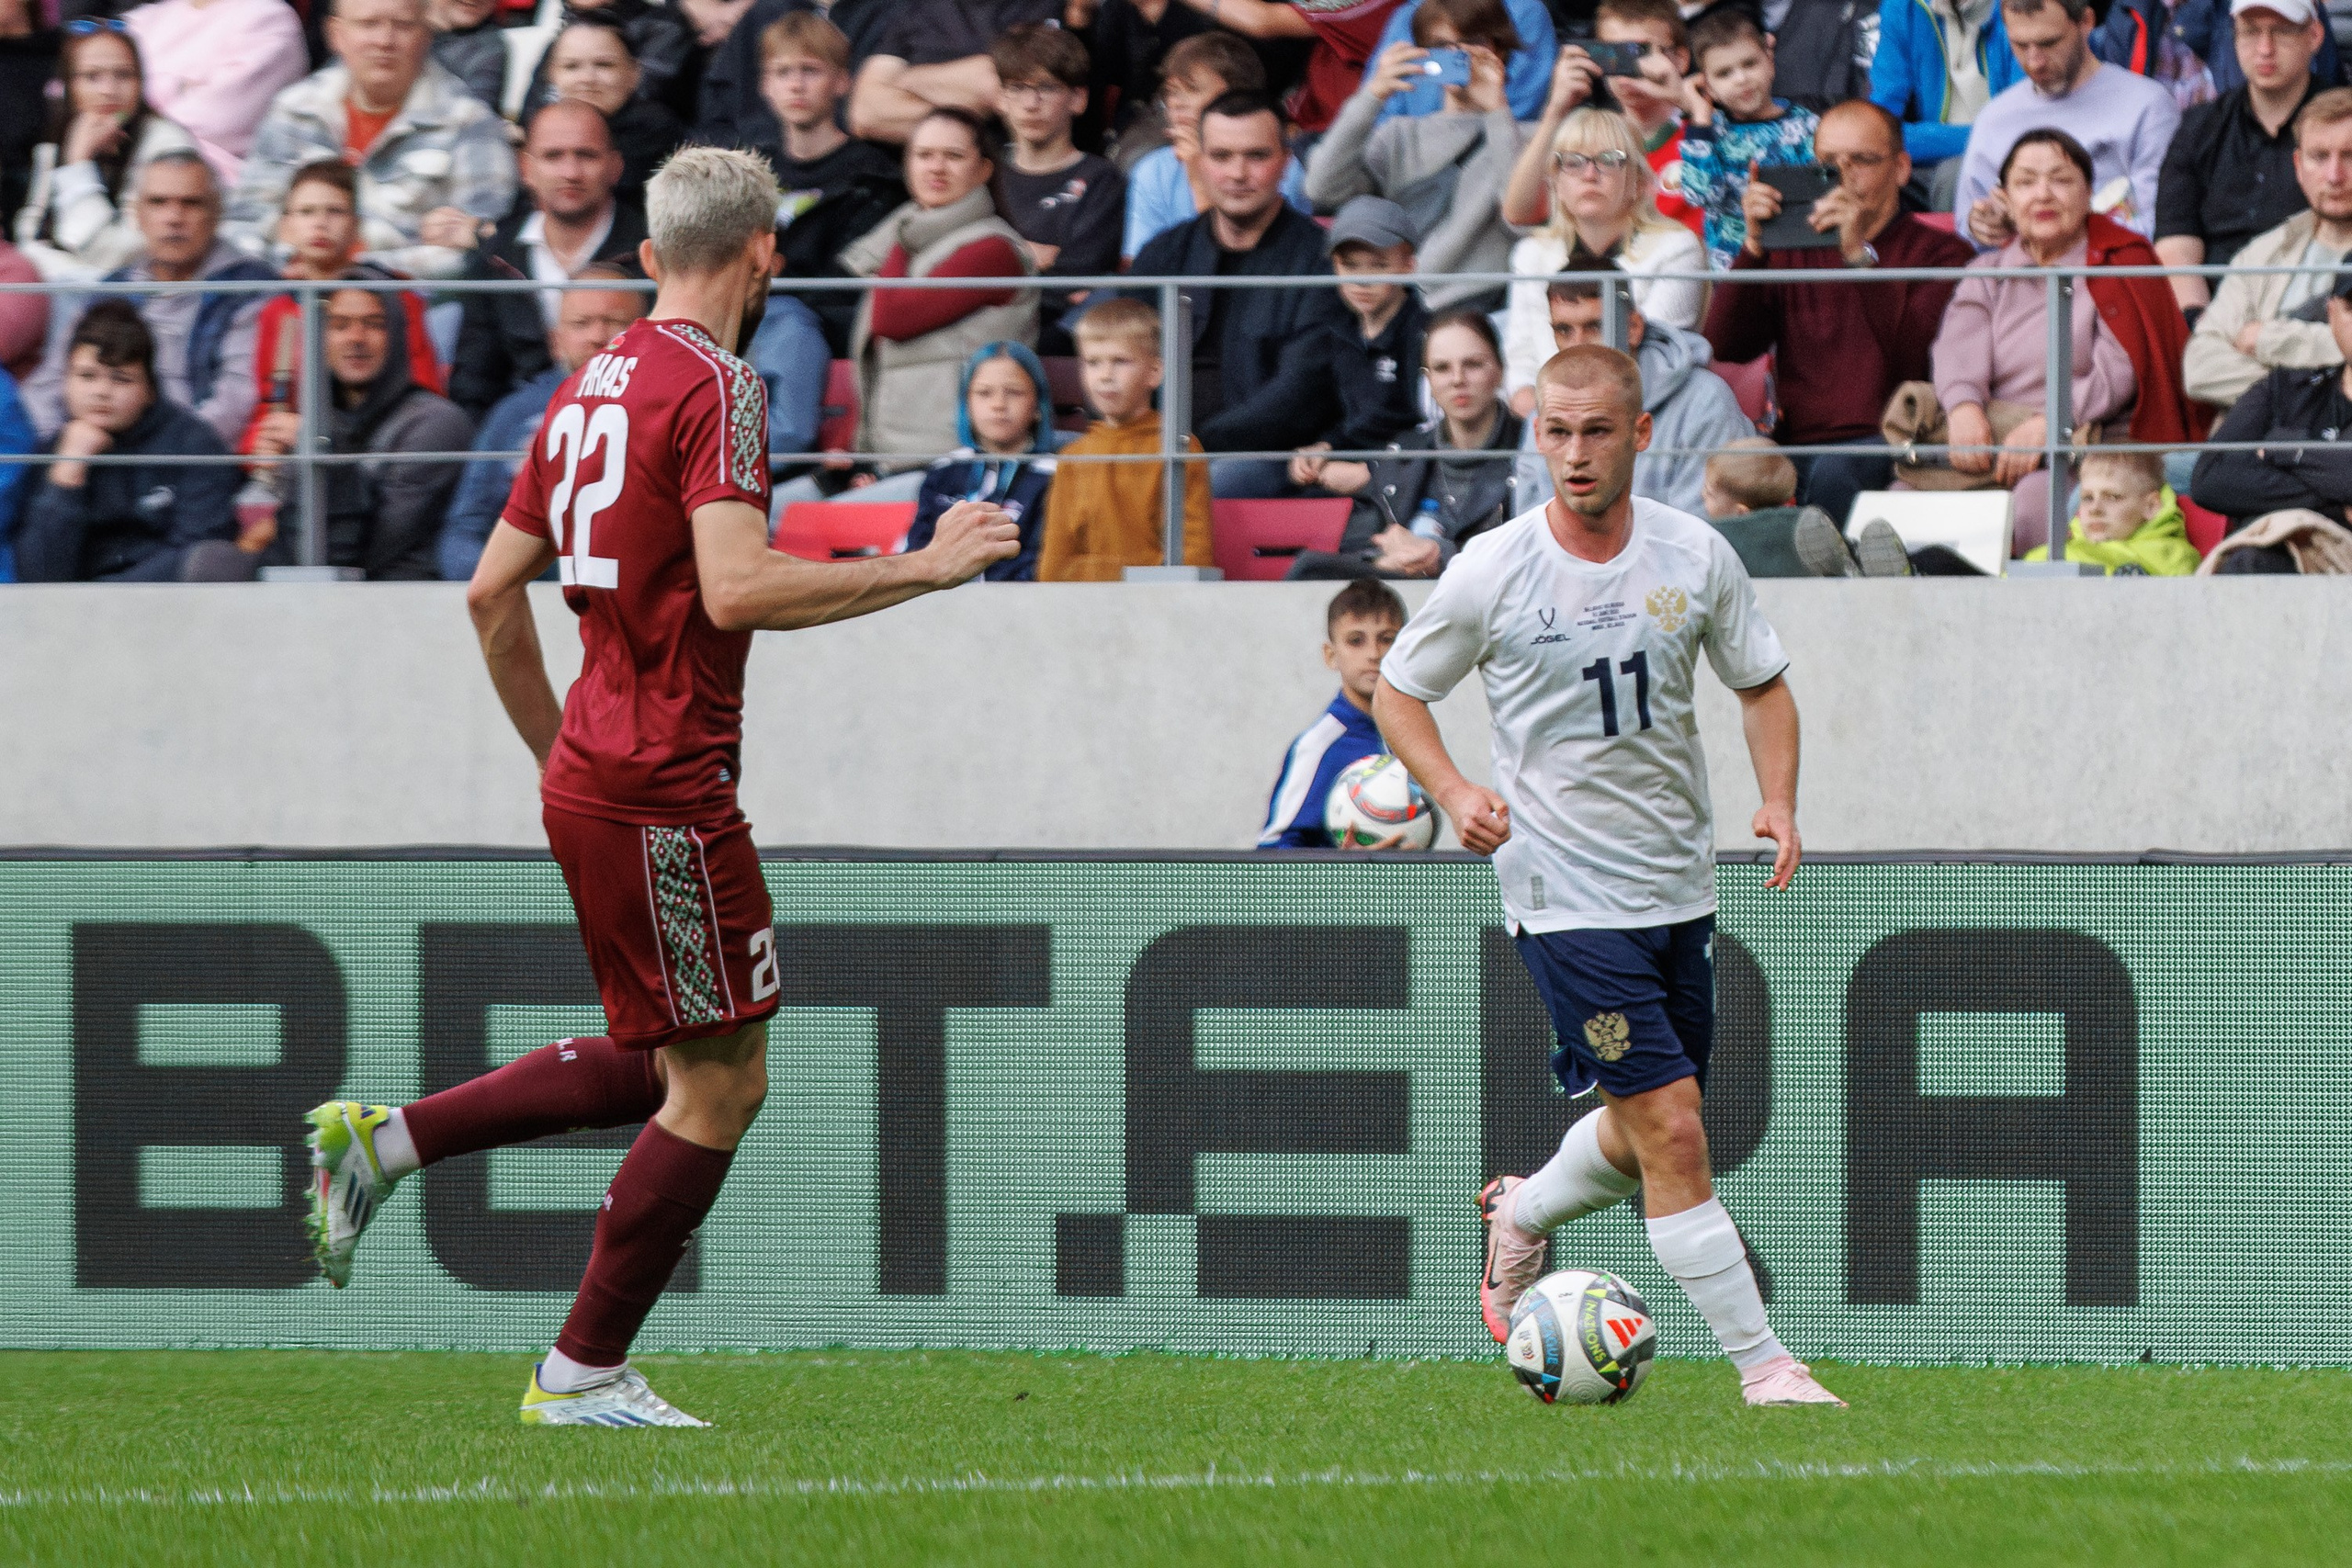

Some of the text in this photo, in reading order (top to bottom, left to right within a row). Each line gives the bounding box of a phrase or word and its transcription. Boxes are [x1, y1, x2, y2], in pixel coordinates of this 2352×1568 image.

[548, 405, 629, 589] 22
[1582, 650, 1652, 737] 11
[1536, 1312, 1560, 1365] LEAGUE
[1584, 1300, 1607, 1363] NATIONS
